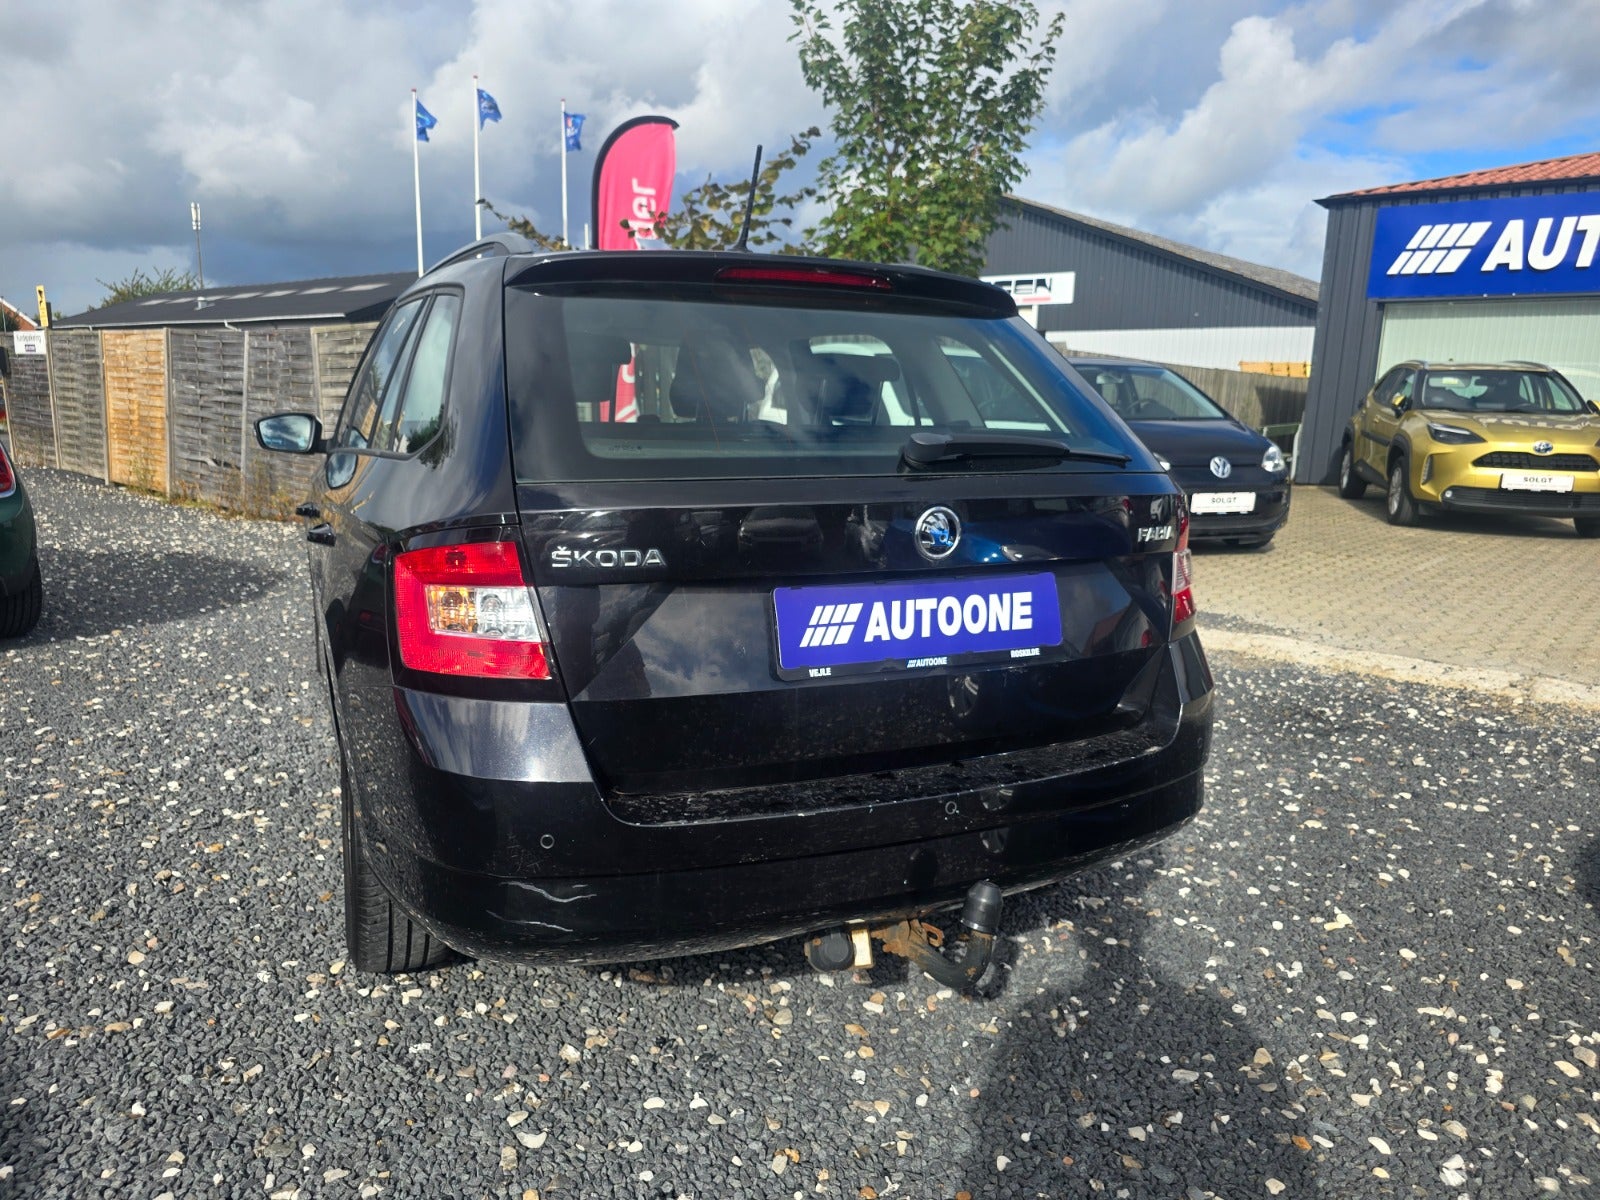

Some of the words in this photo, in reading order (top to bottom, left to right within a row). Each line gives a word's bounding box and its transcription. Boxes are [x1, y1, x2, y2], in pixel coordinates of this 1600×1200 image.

[1480, 214, 1600, 272] AUT
[1523, 476, 1553, 484] SOLGT
[1211, 496, 1237, 504] SOLGT
[551, 545, 667, 568] ŠKODA
[863, 591, 1033, 643] AUTOONE
[1010, 648, 1040, 659] ROSKILDE
[916, 657, 948, 668] AUTOONE
[809, 667, 832, 678] VEJLE
